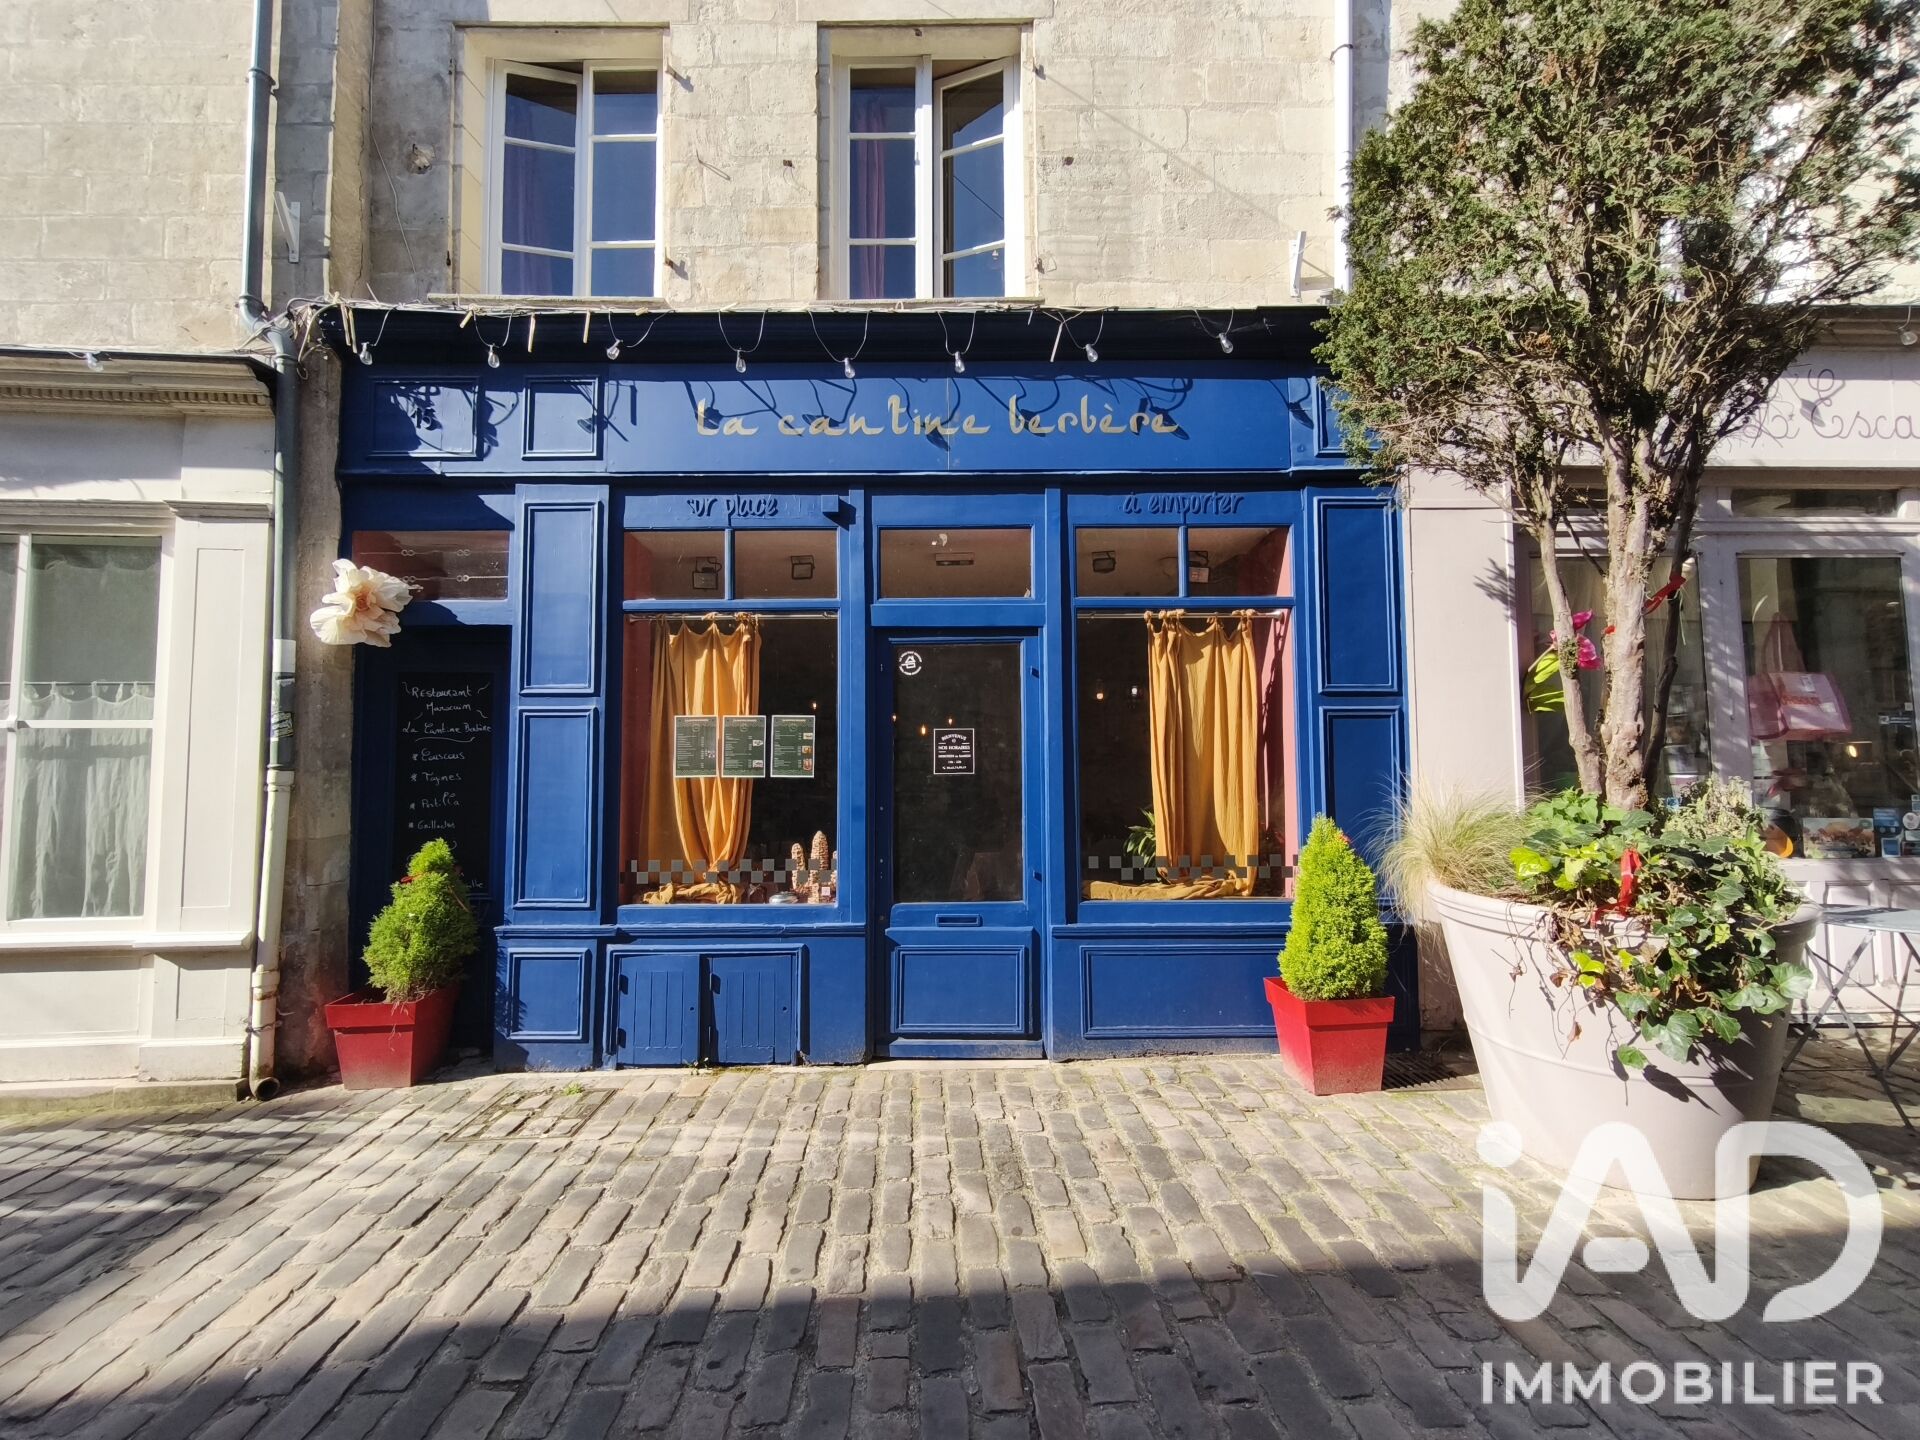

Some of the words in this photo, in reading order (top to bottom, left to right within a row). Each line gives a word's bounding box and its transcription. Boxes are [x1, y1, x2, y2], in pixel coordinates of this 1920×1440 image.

[1009, 394, 1180, 434] berbère
[685, 497, 718, 517] sur
[724, 494, 779, 526] place
[1148, 491, 1244, 524] emporter
